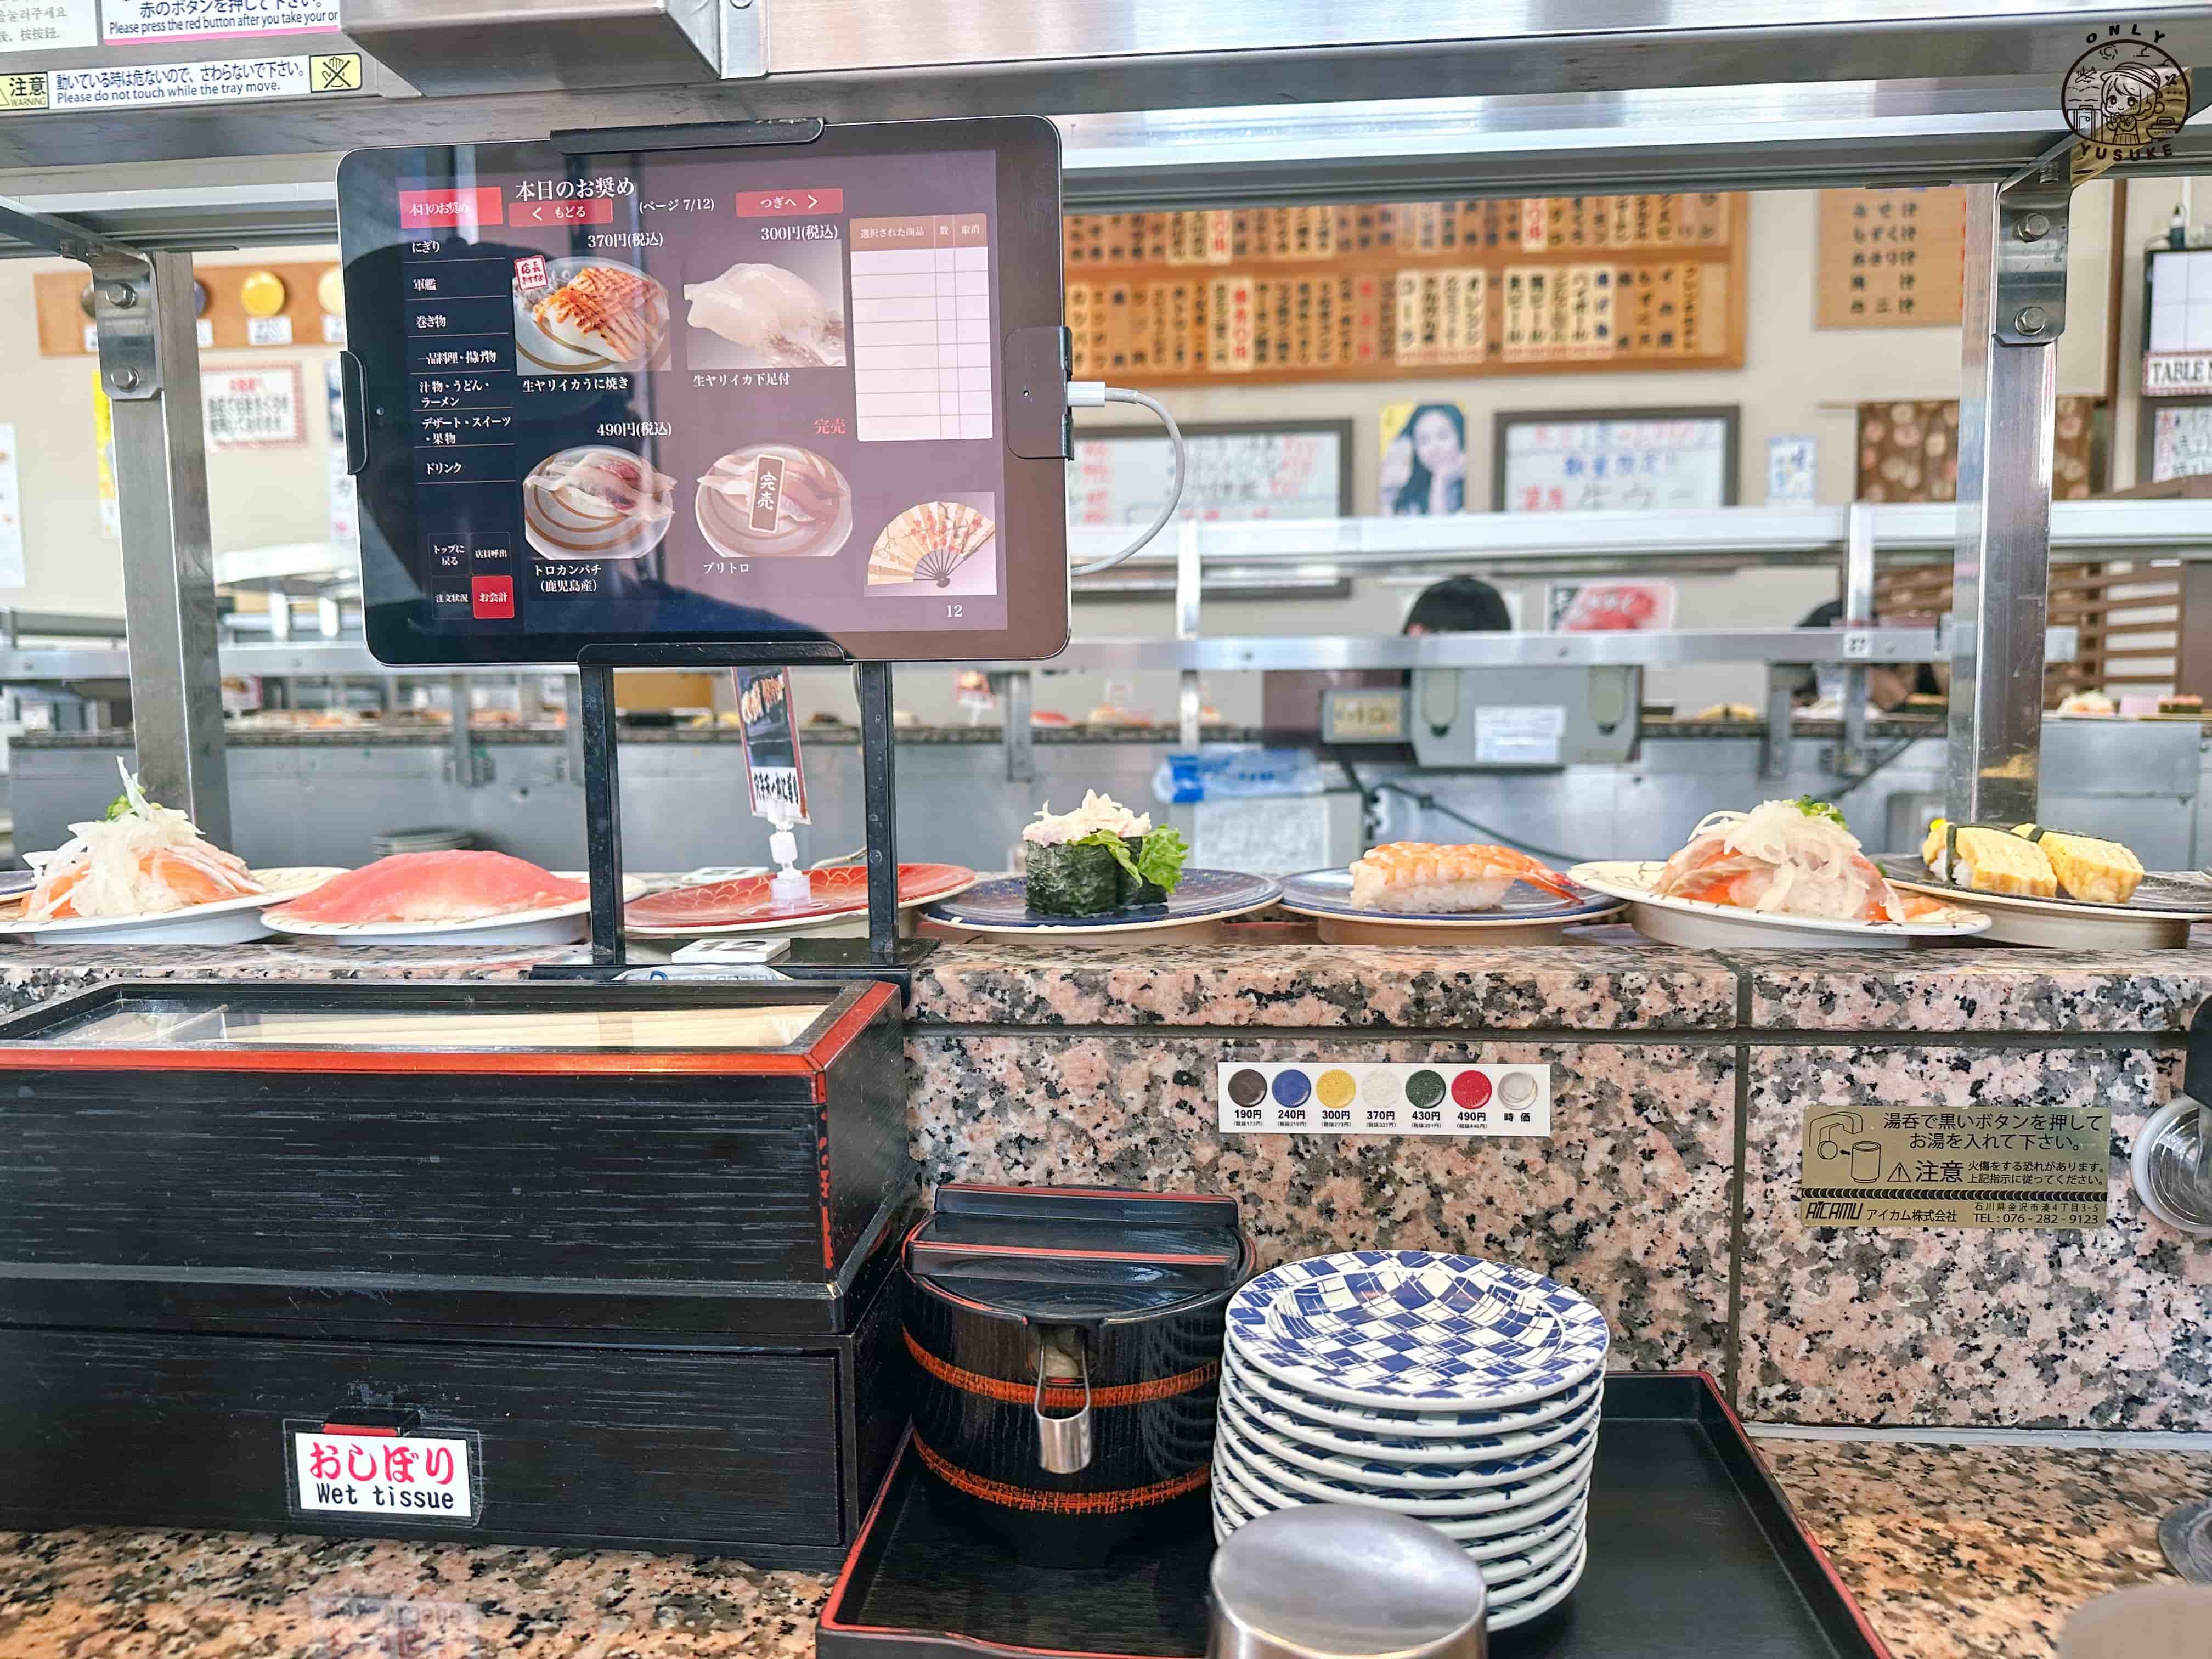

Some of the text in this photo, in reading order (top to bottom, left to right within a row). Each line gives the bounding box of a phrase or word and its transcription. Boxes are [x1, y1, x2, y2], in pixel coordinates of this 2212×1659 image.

[110, 22, 138, 35] Please
[142, 21, 166, 35] press
[167, 18, 184, 31] the
[185, 18, 201, 29] red
[203, 15, 235, 28] button
[237, 12, 259, 26] after
[262, 13, 279, 28] you
[281, 10, 302, 24] take
[303, 12, 326, 25] your
[57, 61, 304, 91] 動いている時は危ないので、さわらないで下さい。
[9, 76, 46, 97] 注意
[57, 82, 281, 104] Please do not touch while the tray move.
[10, 97, 46, 106] WARNING
[516, 177, 634, 202] 本日のお奨め
[639, 198, 715, 215] (ページ 7/12)
[760, 195, 797, 210] つぎへ
[554, 206, 586, 219] もどる
[760, 223, 839, 241] 300円(税込)
[860, 225, 926, 239] 選択された商品
[411, 240, 441, 254] にぎり
[588, 232, 663, 248] 370円(税込)
[416, 314, 447, 329] 巻き物
[2150, 360, 2204, 383] TABLE
[522, 376, 629, 392] 生ヤリイカうに焼き
[692, 372, 790, 388] 生ヤリイカ下足付
[421, 397, 460, 409] ラーメン
[422, 415, 511, 430] デザート・スイーツ
[596, 421, 673, 438] 490円(税込)
[814, 417, 847, 435] 完売
[426, 461, 462, 475] ドリンク
[758, 470, 778, 511] 完売
[433, 544, 466, 555] トップに
[534, 563, 602, 577] トロカンパチ
[702, 561, 750, 575] ブリトロ
[478, 591, 509, 603] お会計
[945, 604, 964, 618] 12
[1234, 1109, 1262, 1120] 190円
[1277, 1110, 1306, 1120] 240円
[1322, 1110, 1350, 1120] 300円
[1367, 1110, 1395, 1121] 370円
[1412, 1111, 1440, 1121] 430円
[1457, 1111, 1486, 1122] 490円
[1883, 1111, 2104, 1131] 湯呑で黒いボタンを押して
[1909, 1132, 2081, 1152] お湯を入れて下さい。
[1915, 1159, 1963, 1183] 注意
[1967, 1160, 2104, 1173] 火傷をする恐れがあります。
[1967, 1173, 2103, 1186] 上記指示に従ってください。
[1866, 1209, 1958, 1222] アイカム株式会社
[309, 1441, 454, 1485] おしぼり
[316, 1482, 454, 1509] Wet tissue
